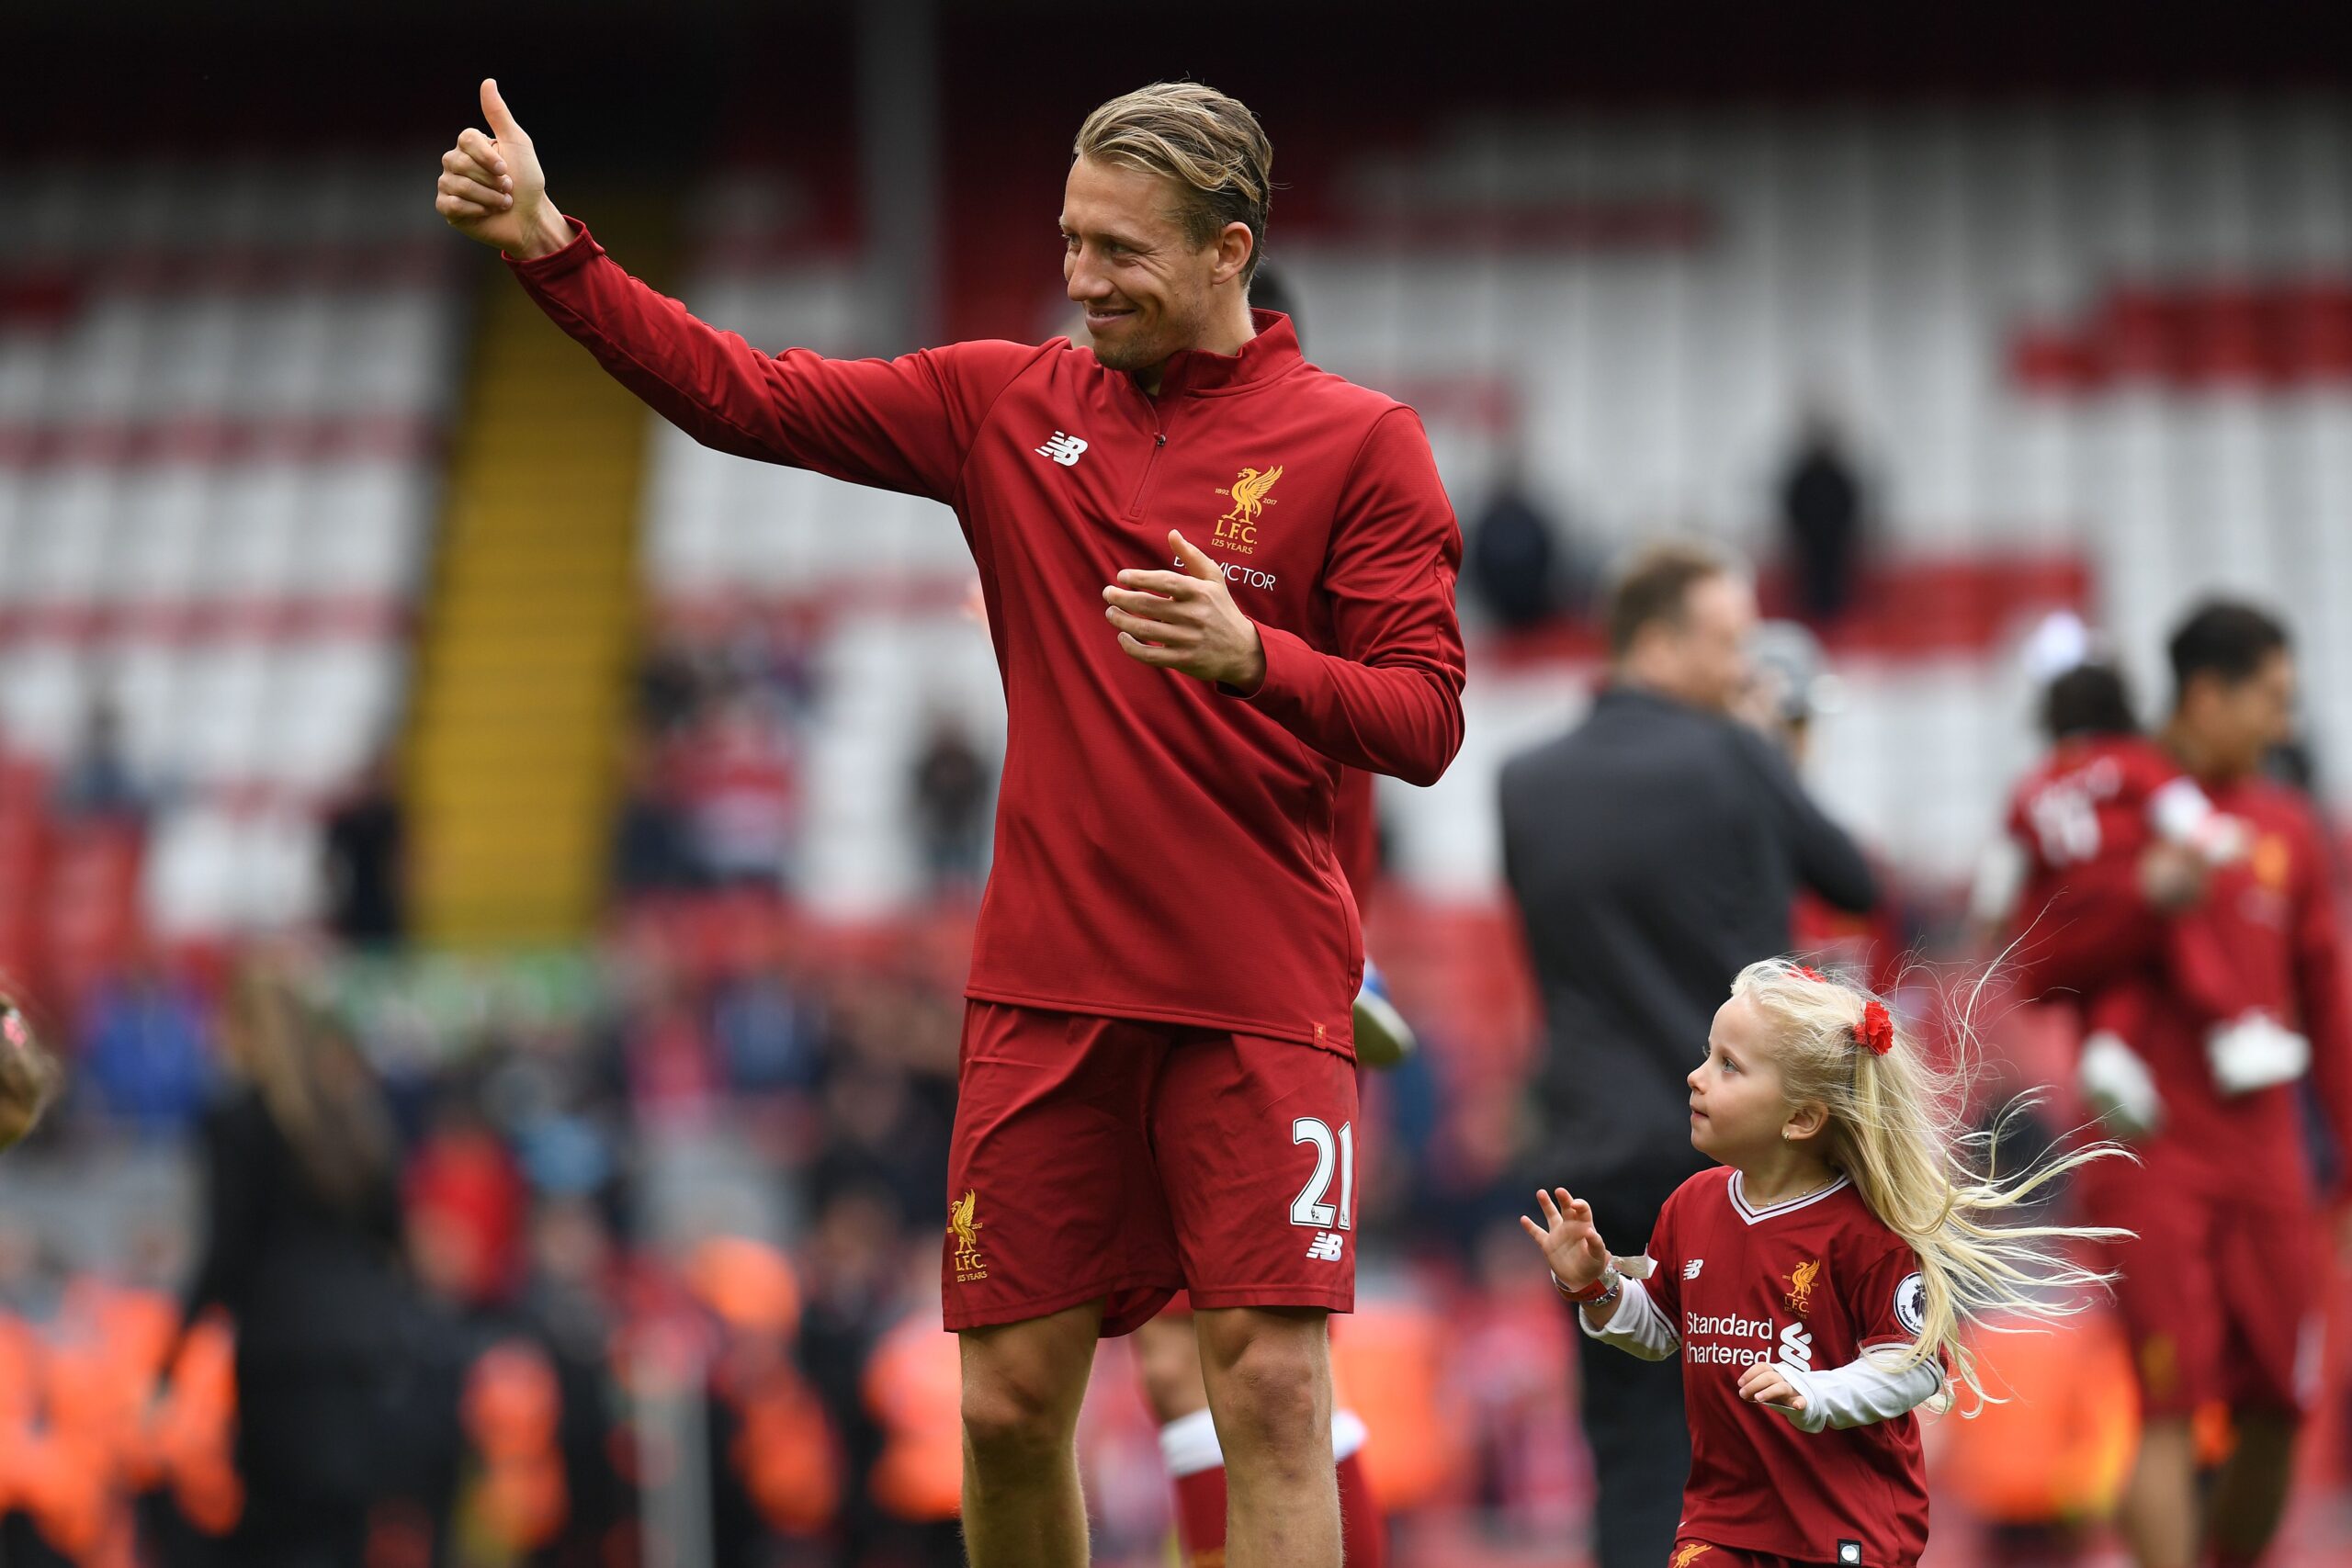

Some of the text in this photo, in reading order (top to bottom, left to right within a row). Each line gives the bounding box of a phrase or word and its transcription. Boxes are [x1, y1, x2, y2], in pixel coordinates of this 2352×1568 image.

[1215, 488, 1230, 496] 1892
[1262, 497, 1278, 505] 2017
[1214, 519, 1258, 545] L.F.C.
[1211, 537, 1254, 555] 125 YEARS
[1290, 1116, 1353, 1231] 21
[967, 1270, 988, 1281] YEARS
[1686, 1311, 1773, 1340] Standard
